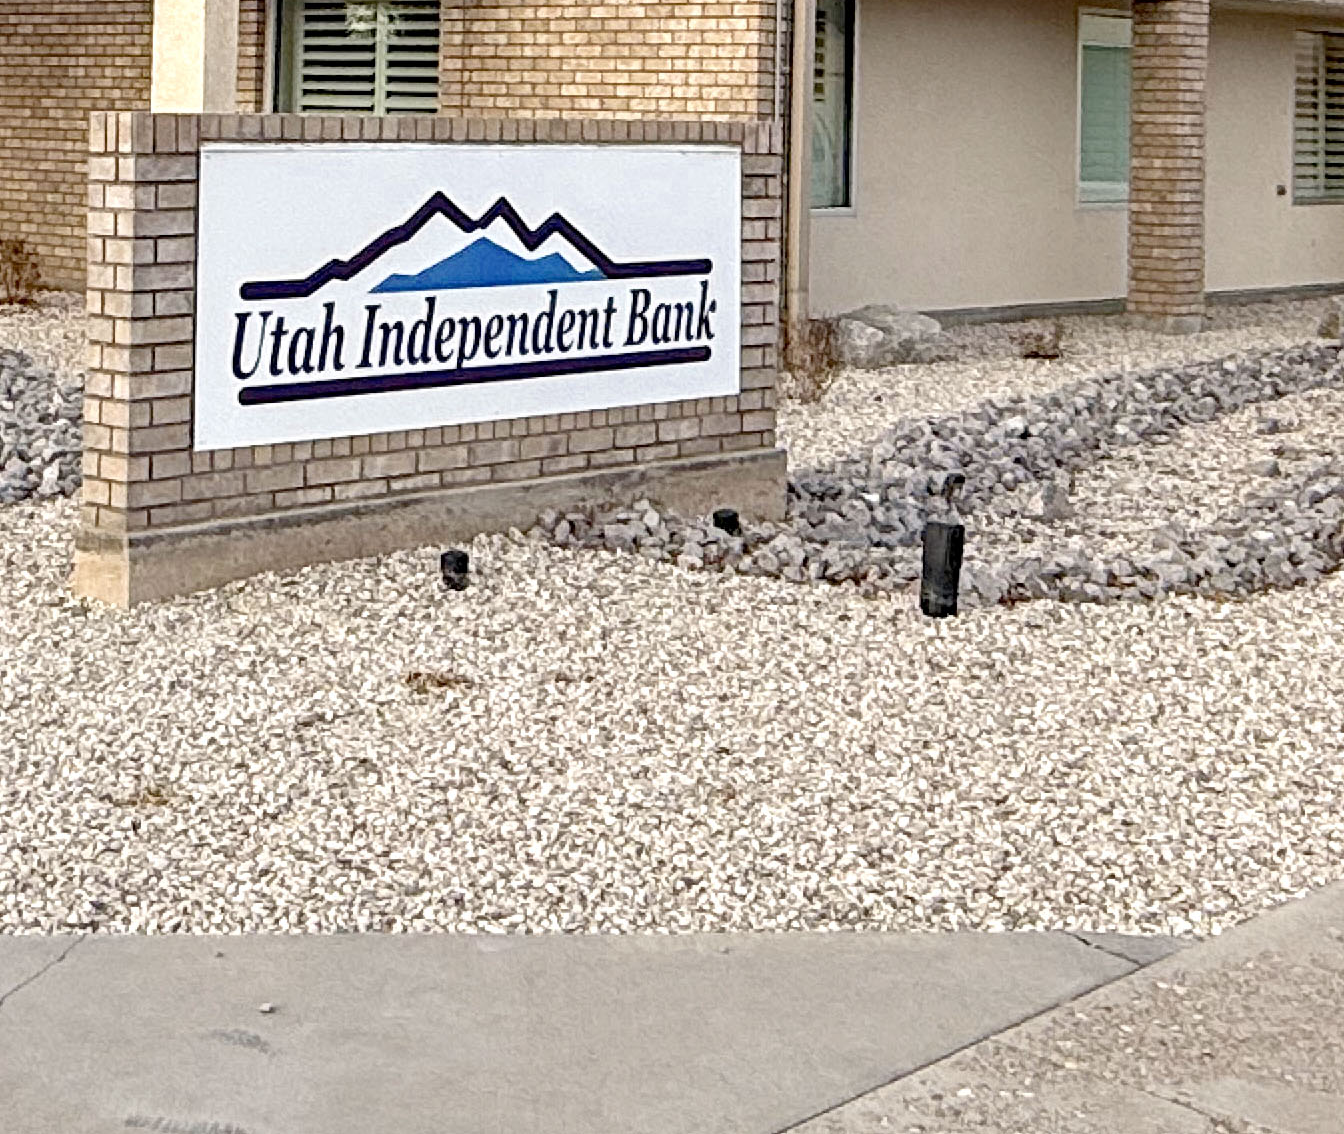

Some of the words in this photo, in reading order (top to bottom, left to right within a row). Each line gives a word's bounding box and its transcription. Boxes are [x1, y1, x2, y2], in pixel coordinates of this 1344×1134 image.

[232, 303, 345, 380] Utah
[355, 290, 615, 370] Independent
[622, 280, 718, 348] Bank
